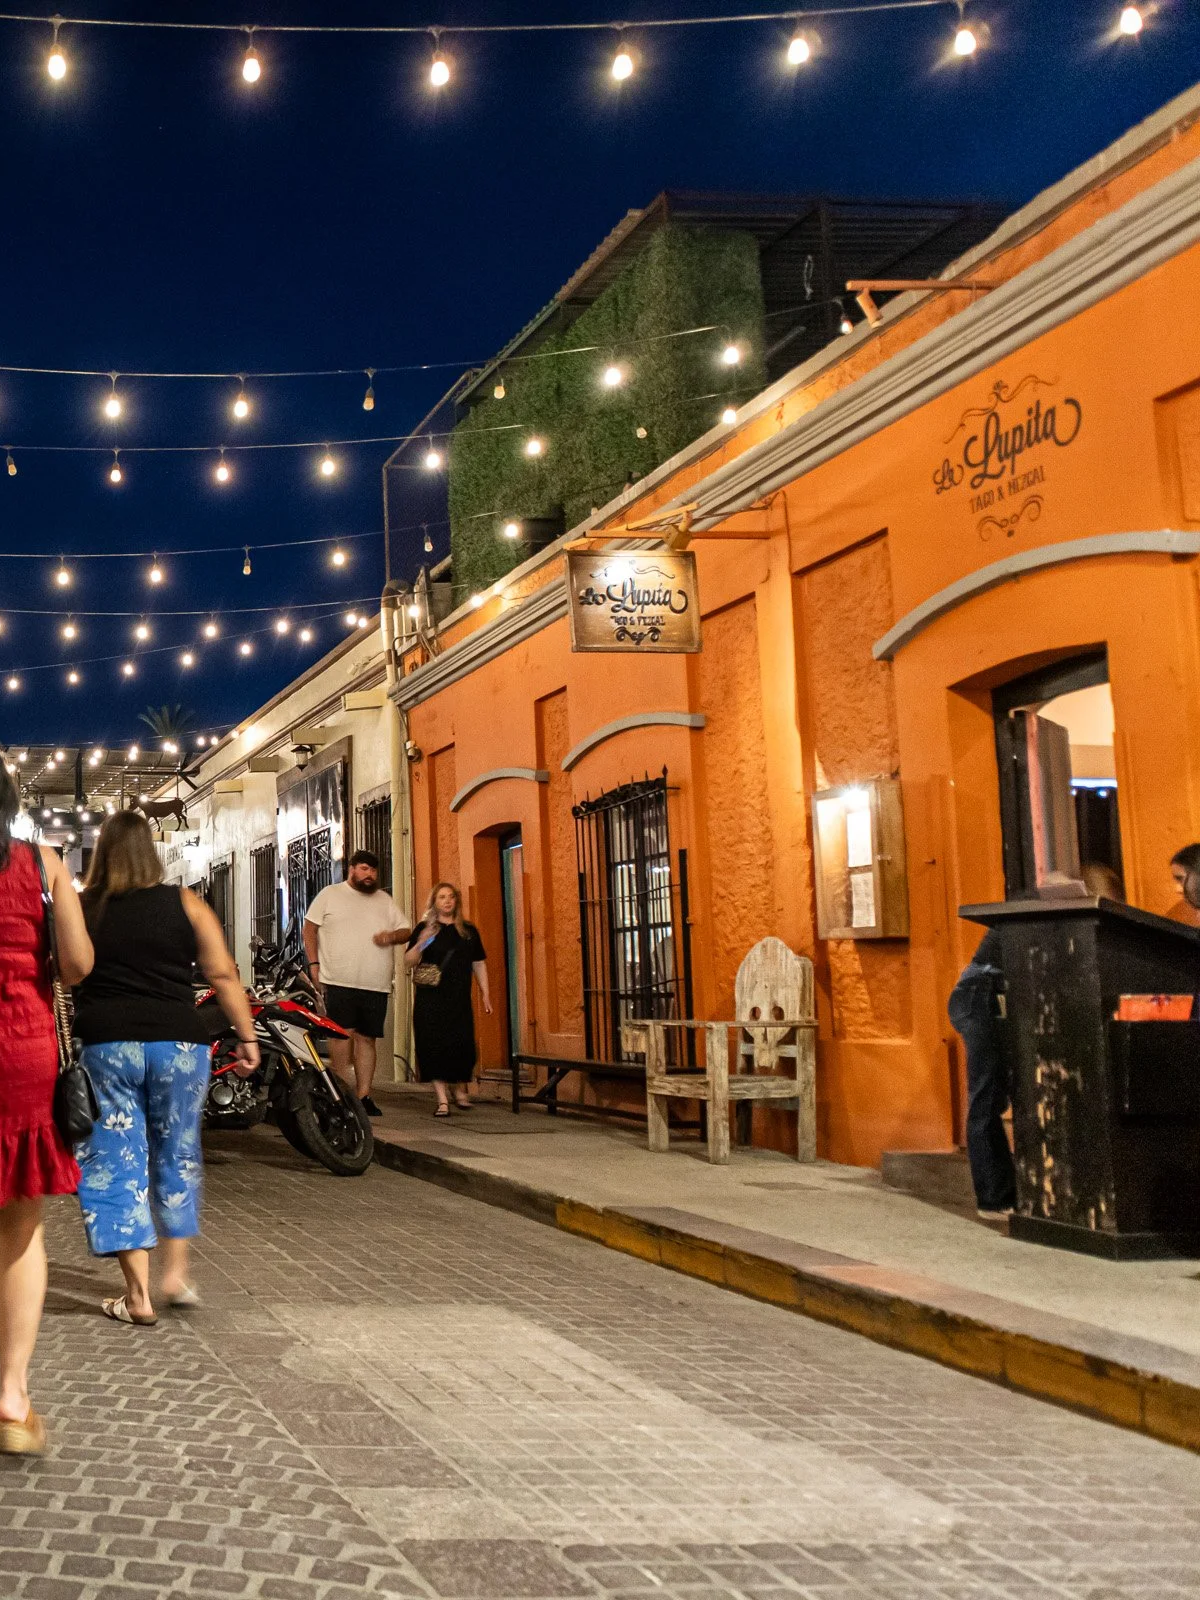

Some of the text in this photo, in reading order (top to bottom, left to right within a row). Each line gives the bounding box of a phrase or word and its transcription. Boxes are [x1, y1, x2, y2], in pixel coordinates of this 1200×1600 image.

[933, 398, 1082, 495] La Lupita
[969, 466, 1045, 514] TACO & MEZCAL
[606, 577, 689, 614] Lupita
